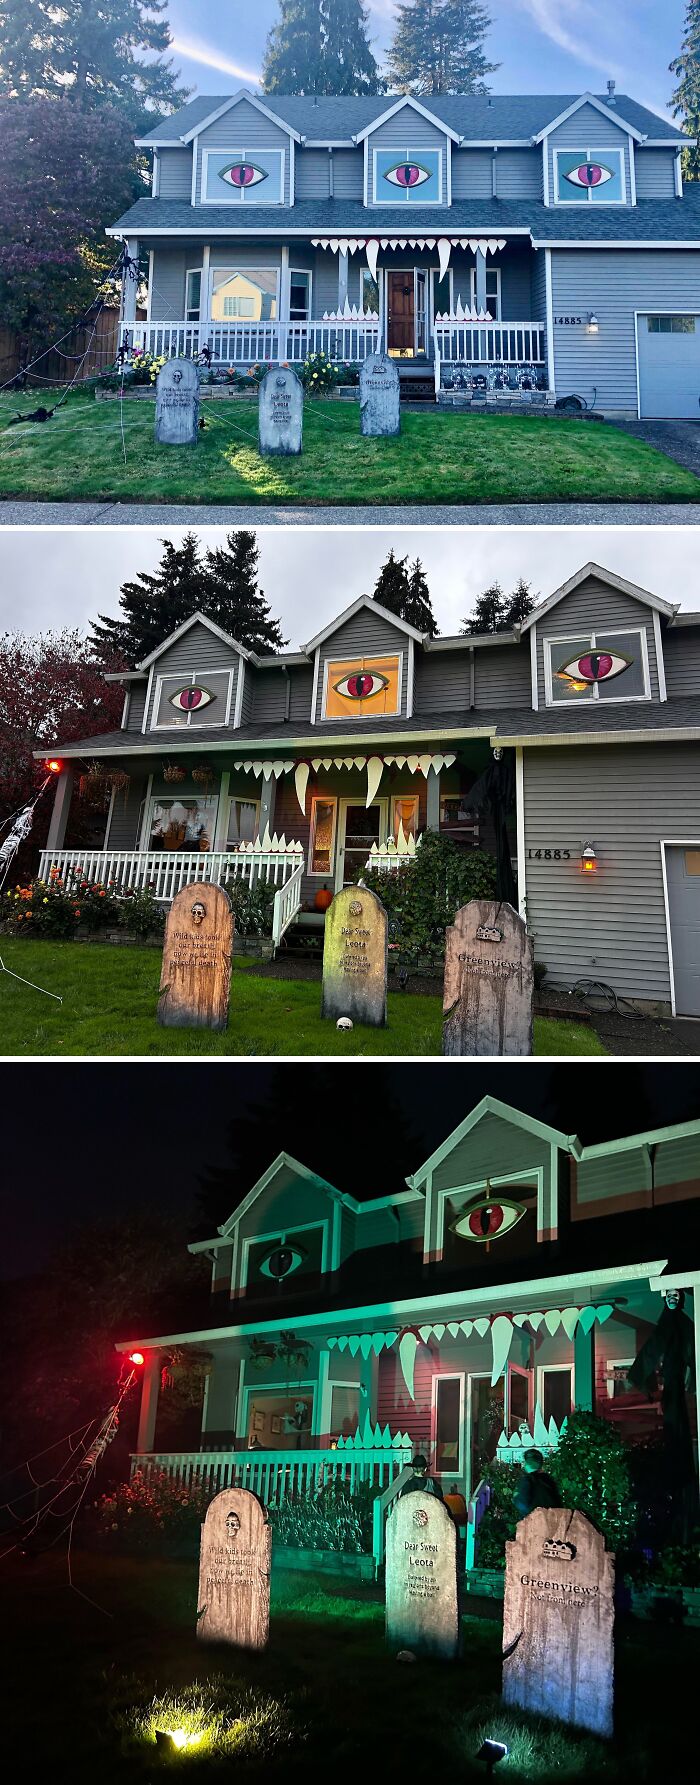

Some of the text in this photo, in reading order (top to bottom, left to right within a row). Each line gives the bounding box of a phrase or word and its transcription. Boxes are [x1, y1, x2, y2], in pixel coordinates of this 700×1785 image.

[554, 317, 582, 325] 14885
[528, 848, 571, 860] 14885
[173, 932, 188, 940] Wild
[345, 940, 366, 948] Leota
[199, 960, 218, 968] death
[225, 1547, 239, 1555] kids
[404, 1541, 439, 1552] Dear Sweet
[409, 1556, 434, 1567] Leota
[520, 1574, 599, 1597] Greenview?
[529, 1591, 587, 1608] Not from here
